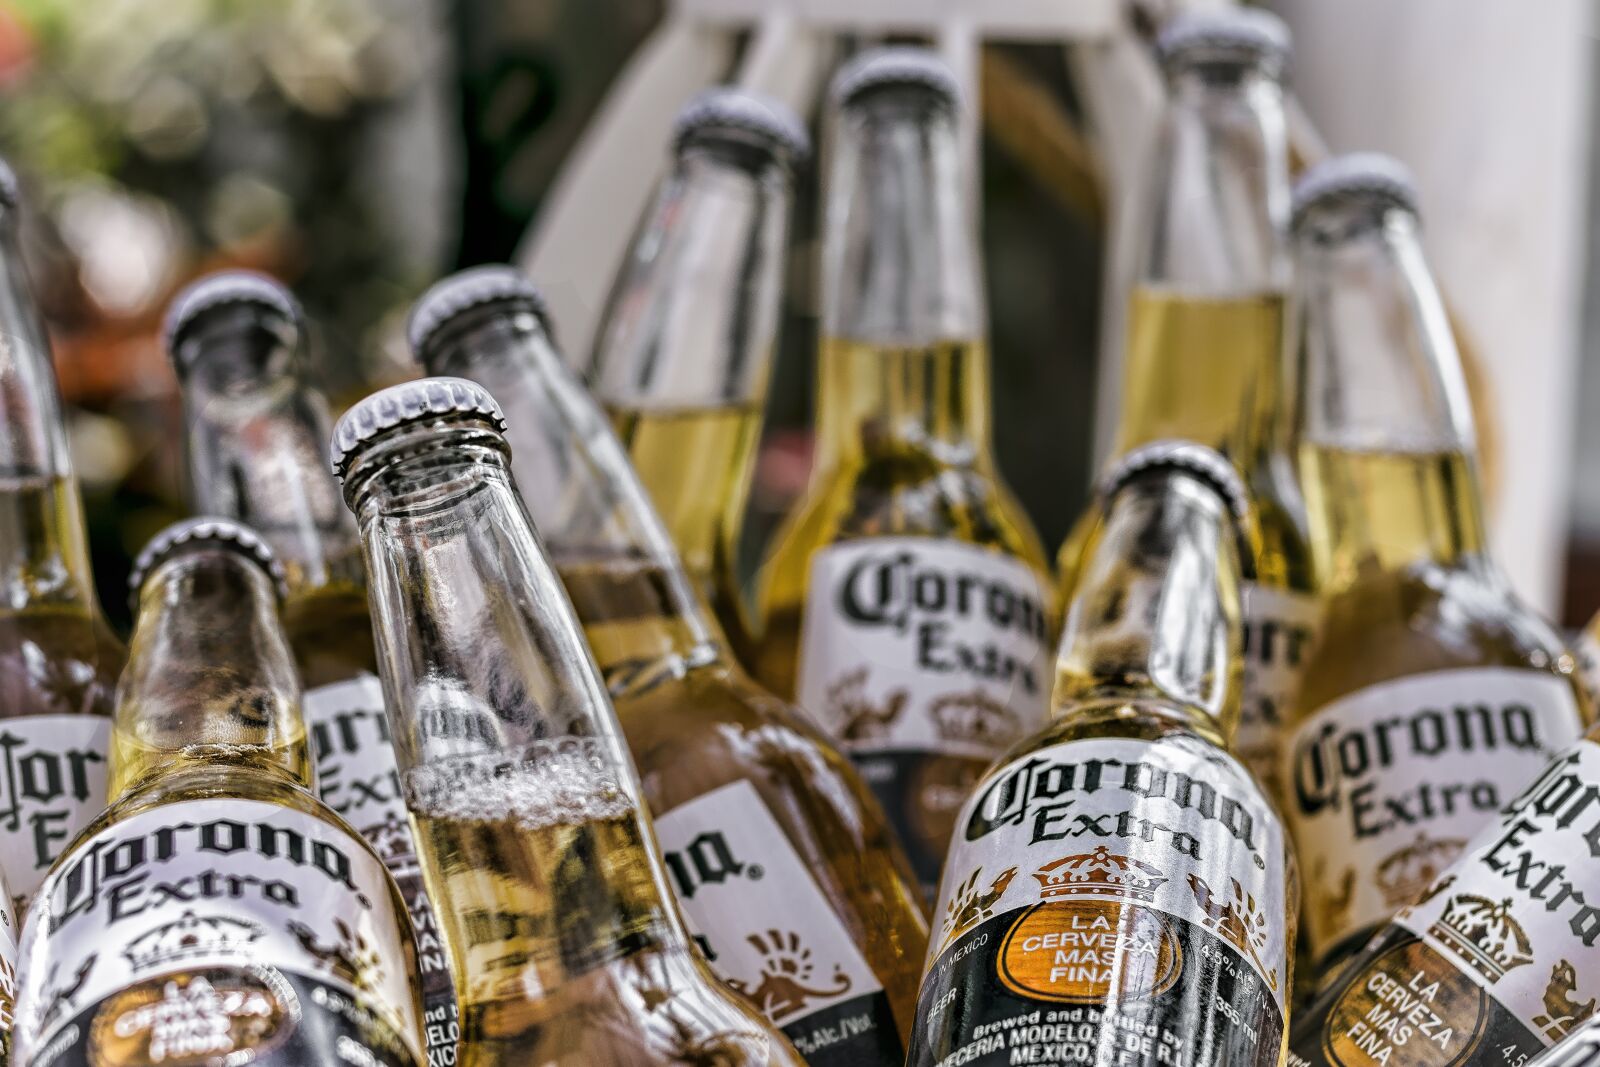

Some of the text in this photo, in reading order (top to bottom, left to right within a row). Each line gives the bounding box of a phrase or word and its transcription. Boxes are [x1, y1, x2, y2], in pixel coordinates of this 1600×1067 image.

[1294, 701, 1541, 817] Corona
[966, 758, 1256, 852] Corona
[1350, 780, 1498, 840] Extra
[1028, 800, 1204, 861] Extra
[48, 818, 358, 937] Corona
[105, 868, 300, 924] Extra
[1480, 819, 1600, 947] Extra
[1071, 915, 1112, 931] LA
[948, 933, 989, 968] MEXICO
[1022, 932, 1157, 958] CERVEZA
[1054, 949, 1116, 966] MAS
[1050, 966, 1114, 984] FINA
[1408, 970, 1441, 1003] LA
[926, 987, 957, 1024] BEER
[1216, 995, 1241, 1026] 355
[1365, 1003, 1413, 1046] MAS
[1367, 971, 1454, 1050] CERVEZA
[973, 1010, 1041, 1041] Brewed
[1046, 1007, 1083, 1024] and
[1163, 1028, 1184, 1051] by
[1008, 1023, 1098, 1047] MODELO,
[1346, 1021, 1393, 1067] FINA
[1009, 1043, 1094, 1066] MEXICO,
